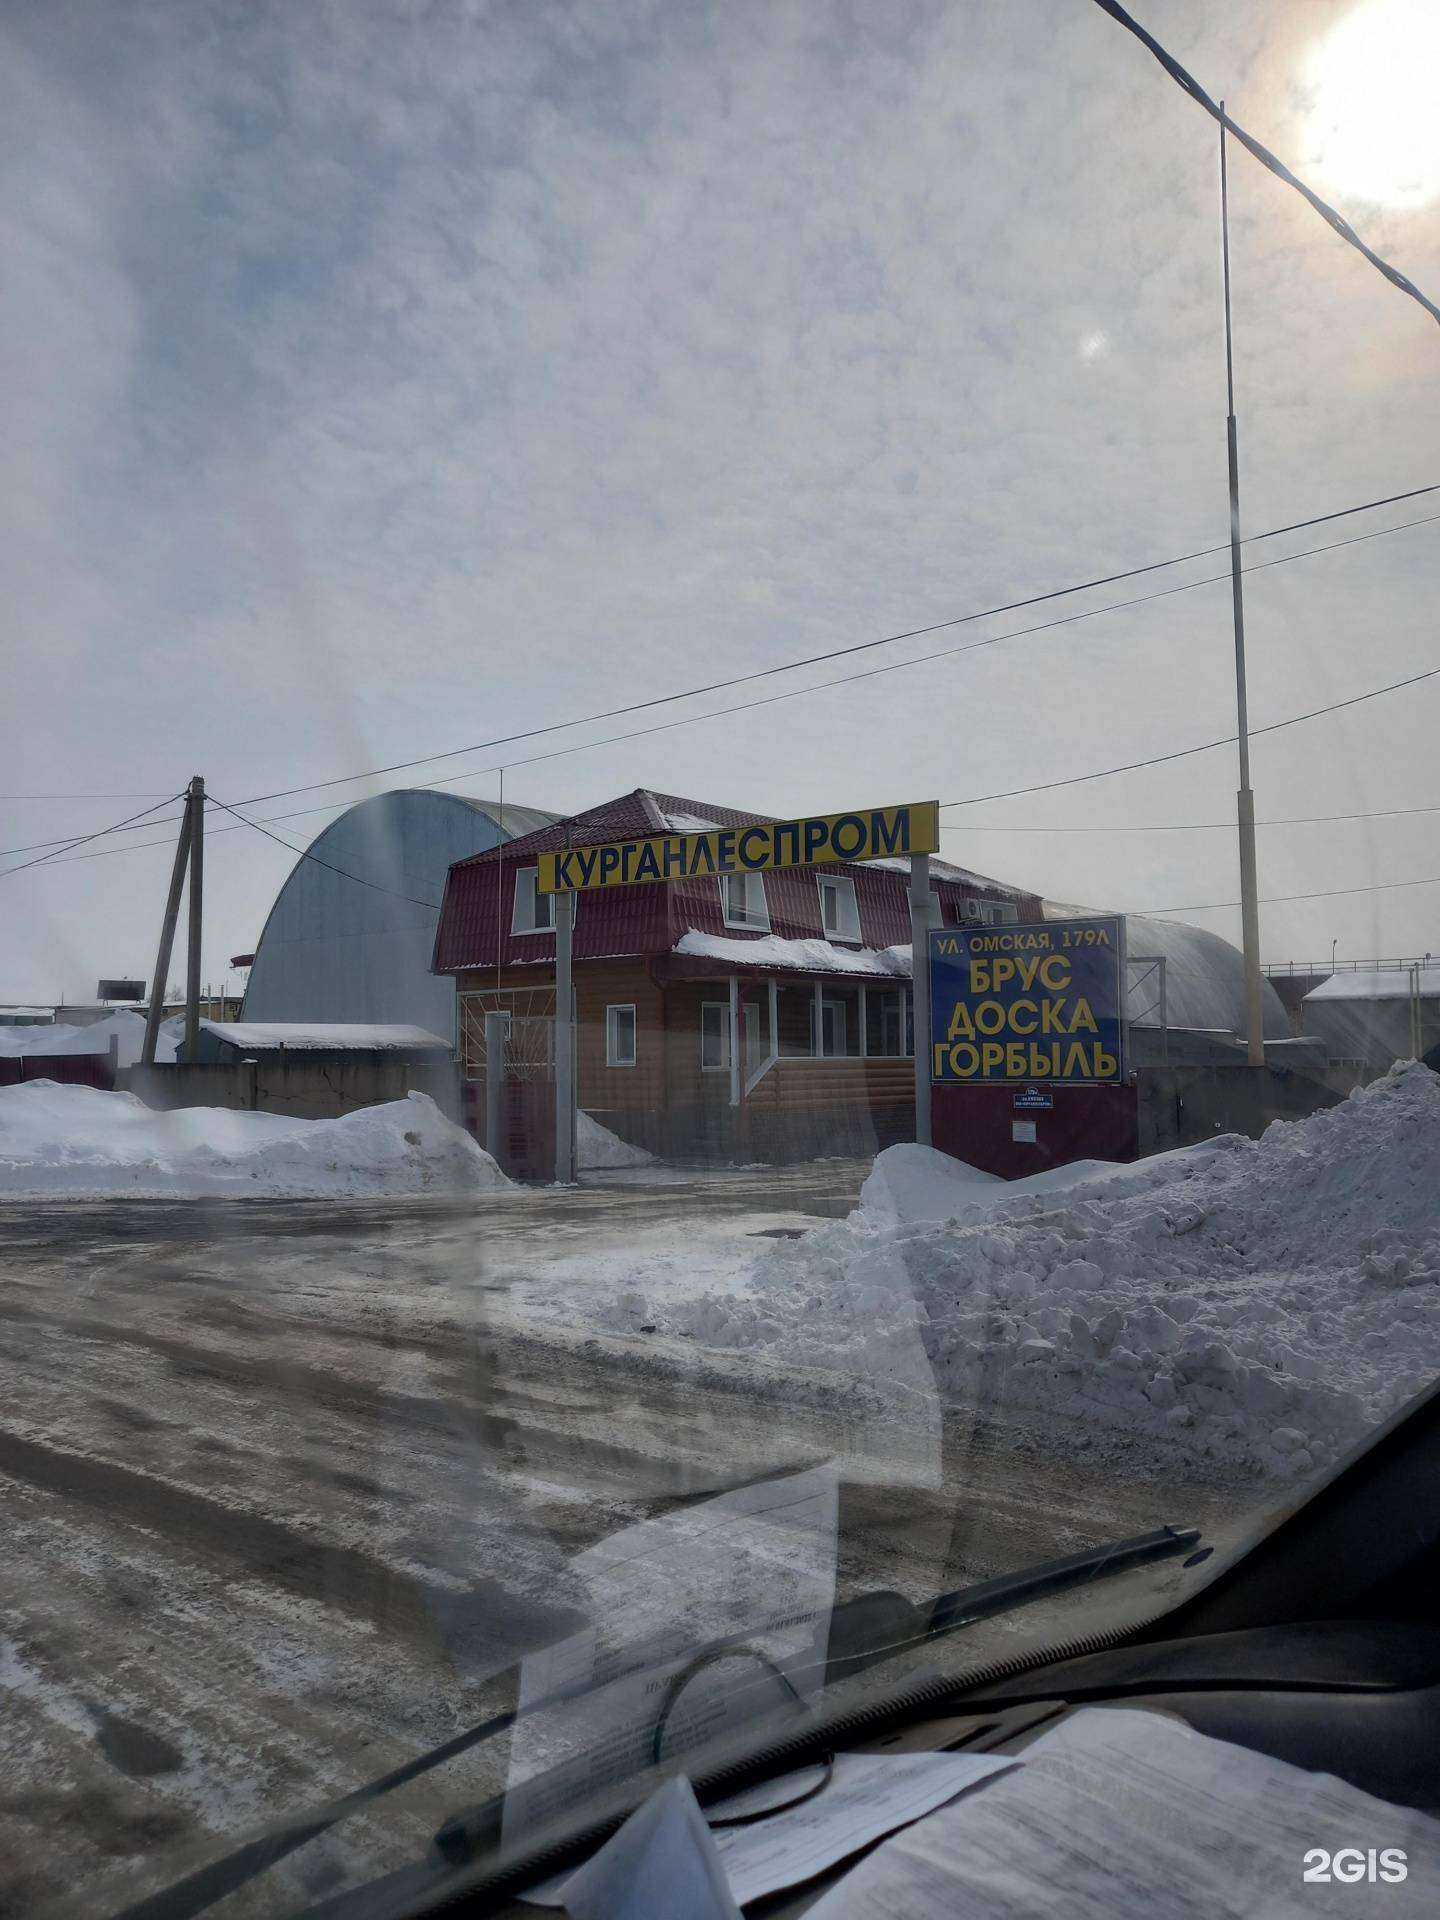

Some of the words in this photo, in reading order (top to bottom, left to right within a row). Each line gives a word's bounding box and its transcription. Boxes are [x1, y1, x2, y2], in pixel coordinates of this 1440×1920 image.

[554, 808, 909, 889] КУРГАНЛЕСПРОМ
[937, 939, 963, 954] УЛ.
[1062, 929, 1110, 947] 179Л
[970, 955, 1072, 993] БРУС
[948, 998, 1098, 1041] ДОСКА
[934, 1042, 1117, 1077] ГОРБЫЛЬ
